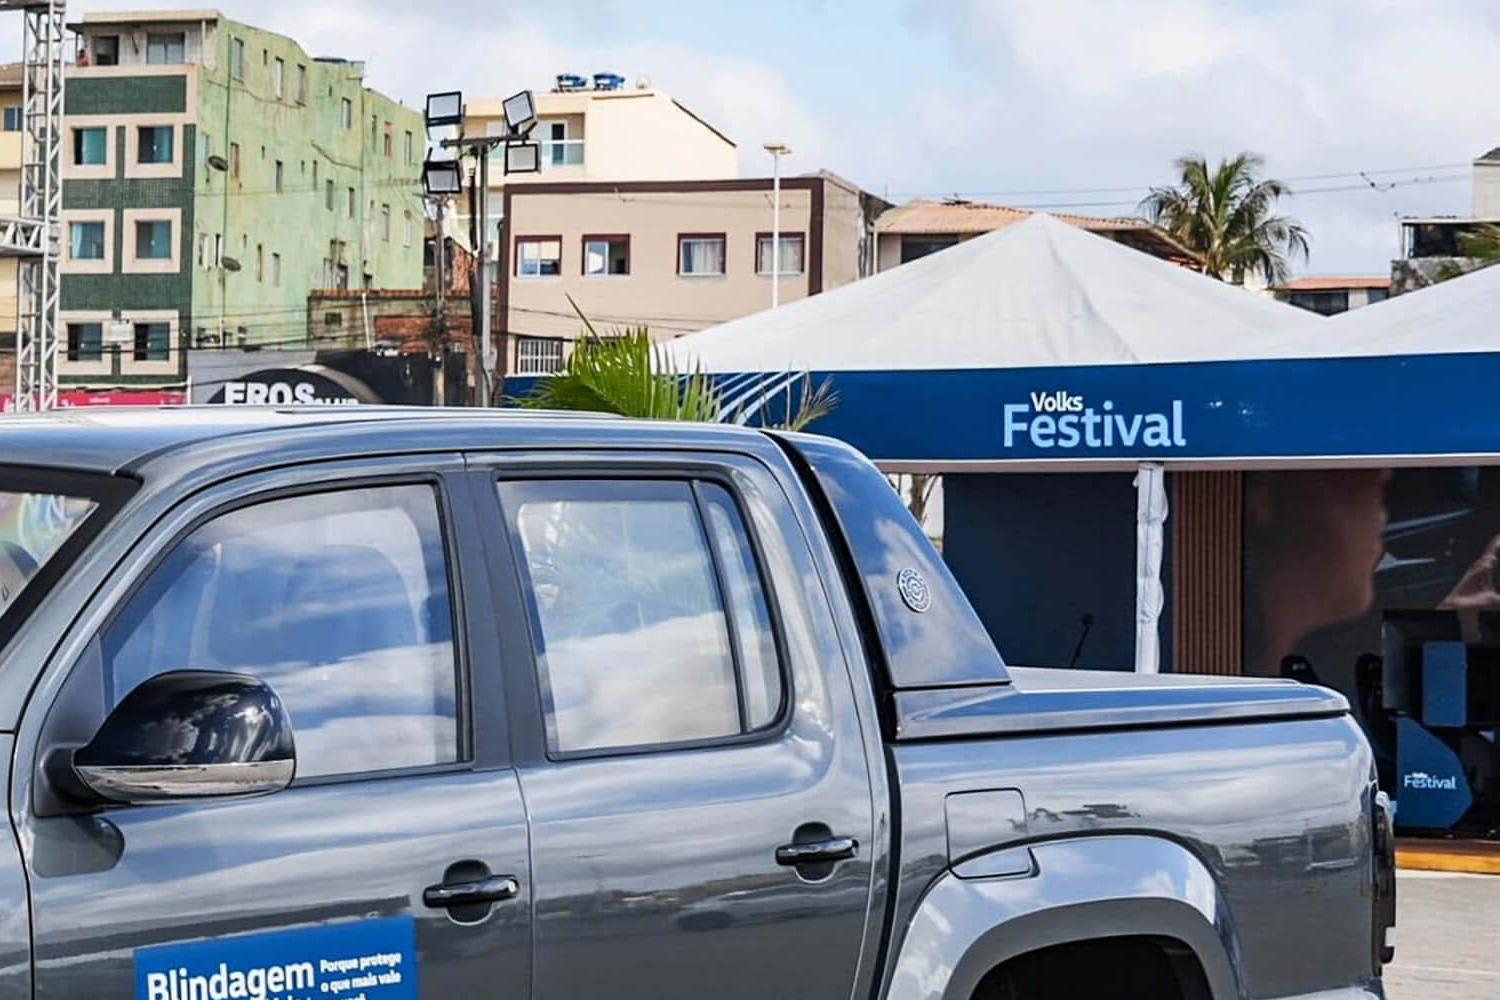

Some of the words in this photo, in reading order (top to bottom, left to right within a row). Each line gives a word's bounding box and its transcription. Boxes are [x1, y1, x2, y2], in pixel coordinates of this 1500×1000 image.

[225, 382, 315, 405] EROS
[1031, 391, 1083, 412] Volks
[1004, 400, 1188, 448] Festival
[1404, 775, 1456, 790] Festival
[320, 958, 359, 973] Porque
[359, 952, 402, 971] protege
[321, 983, 329, 992] o
[330, 979, 351, 994] que
[352, 972, 377, 988] mais
[379, 969, 402, 985] vale
